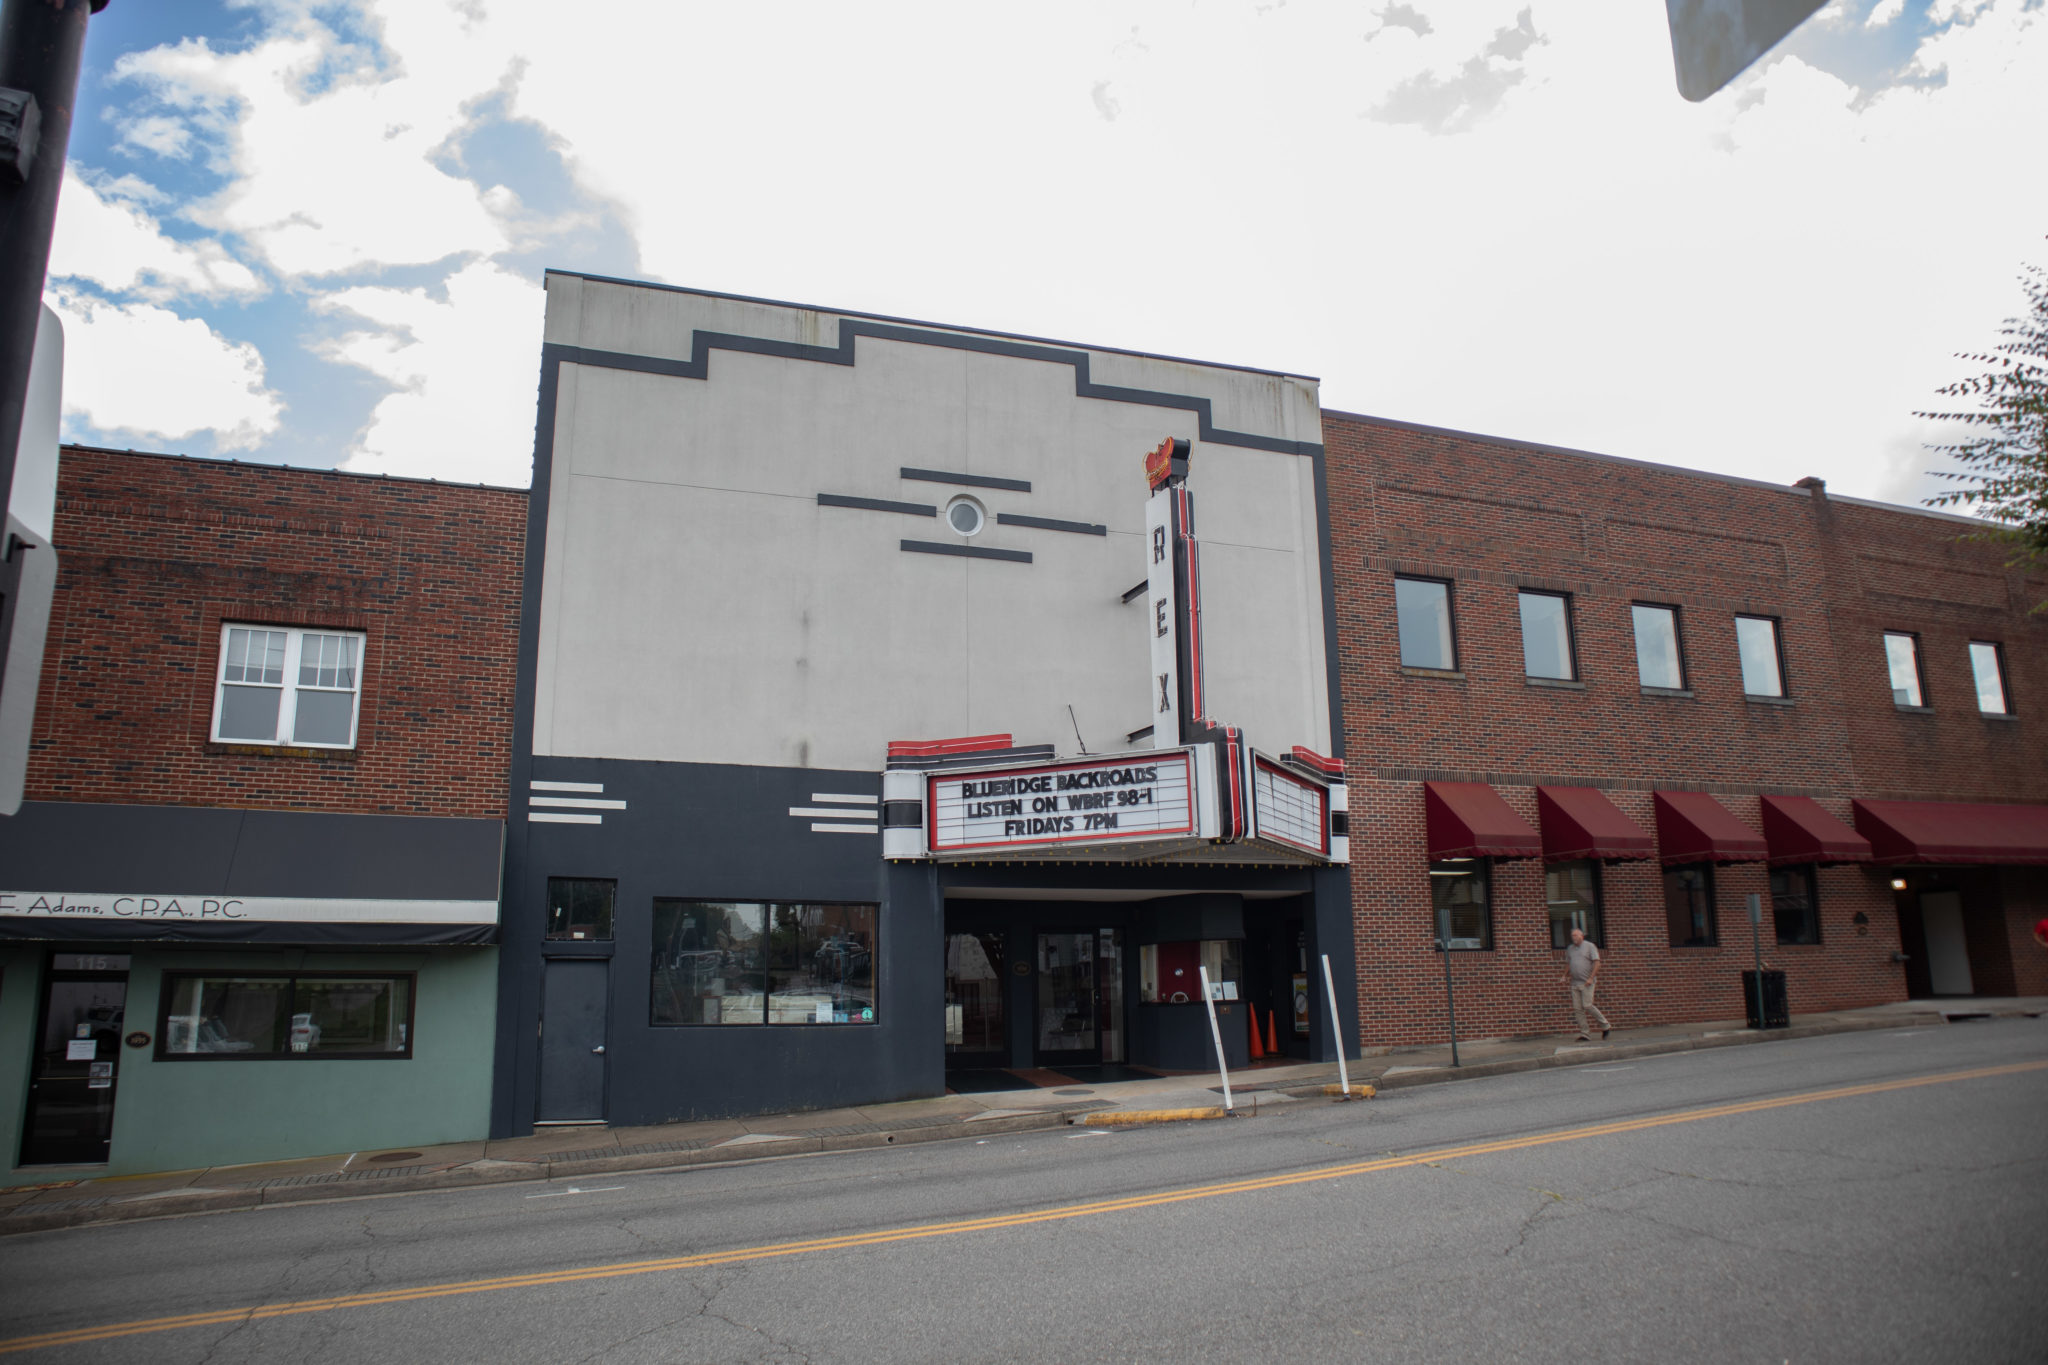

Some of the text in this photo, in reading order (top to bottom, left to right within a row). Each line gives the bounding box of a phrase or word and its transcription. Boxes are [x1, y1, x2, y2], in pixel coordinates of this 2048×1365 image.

[1153, 524, 1170, 714] REX
[962, 766, 1158, 799] BLUERIDGE BACKROADS
[967, 799, 1023, 818] LISTEN
[1032, 795, 1058, 813] ON
[1067, 791, 1114, 811] WBRF
[1004, 812, 1118, 836] FRIDAYS 7PM
[26, 896, 104, 915] Adams,
[201, 899, 248, 918] P.C.
[77, 957, 107, 970] 115
